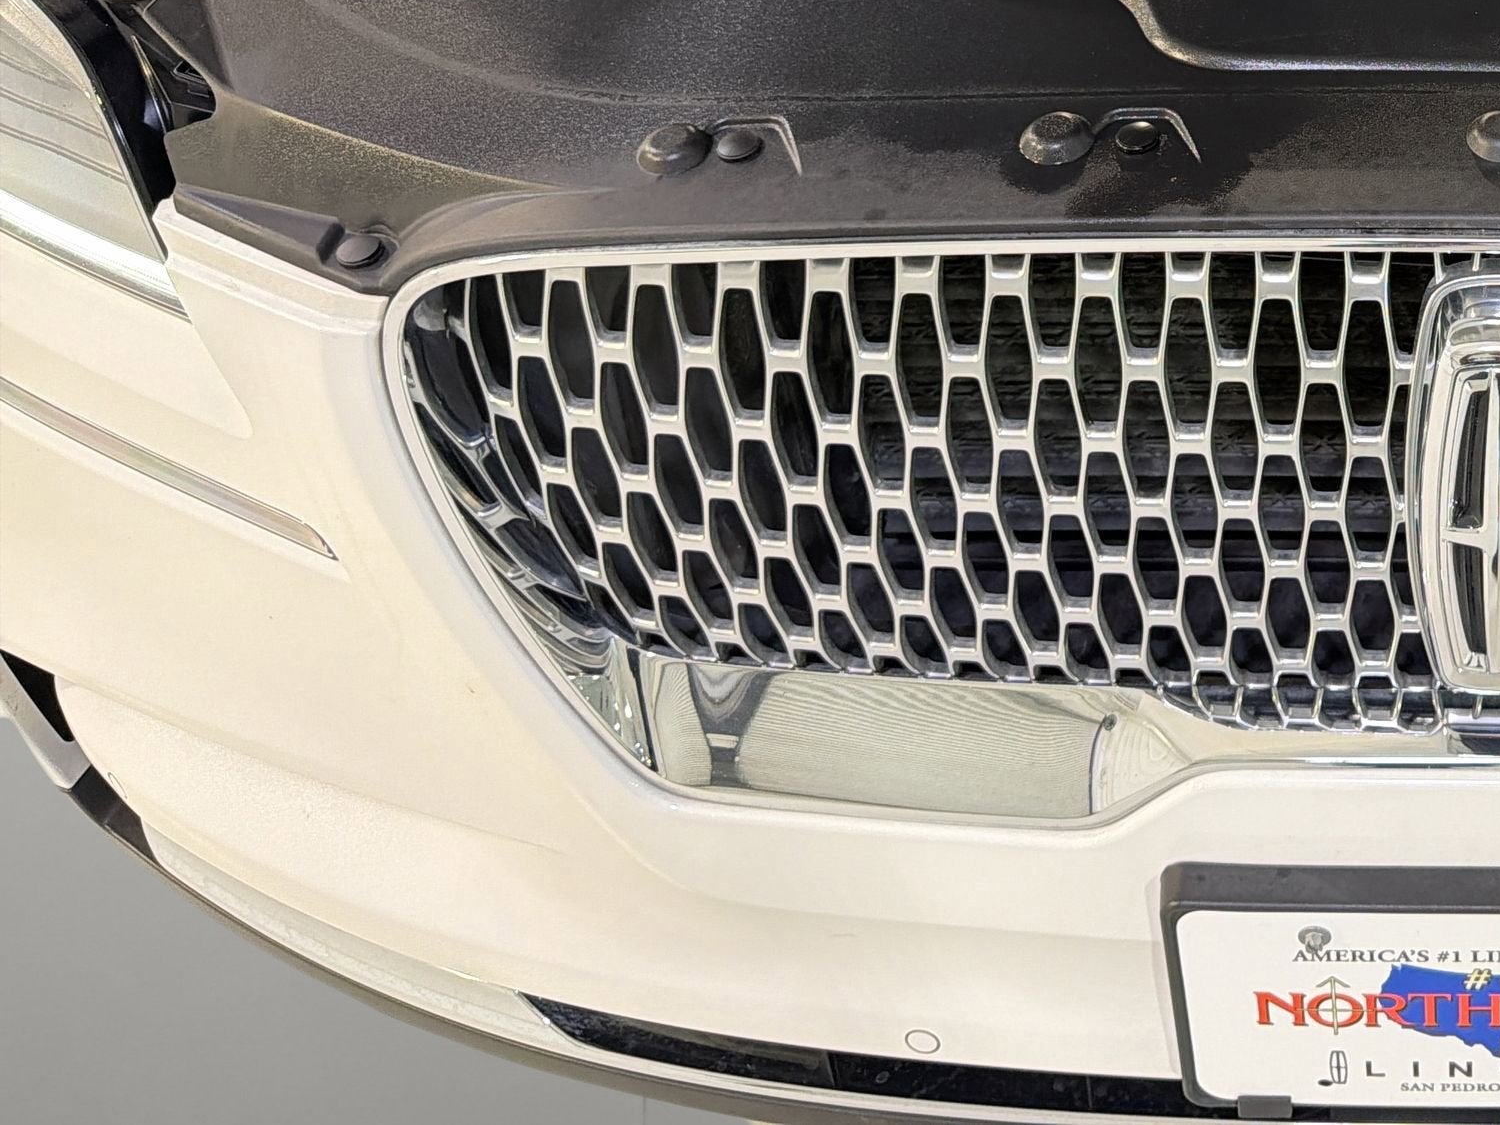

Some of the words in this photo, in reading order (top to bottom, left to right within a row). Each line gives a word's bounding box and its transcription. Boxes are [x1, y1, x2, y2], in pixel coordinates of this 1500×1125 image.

[1292, 948, 1429, 963] AMERICA'S
[1437, 949, 1463, 963] #1
[1400, 1081, 1435, 1092] SAN
